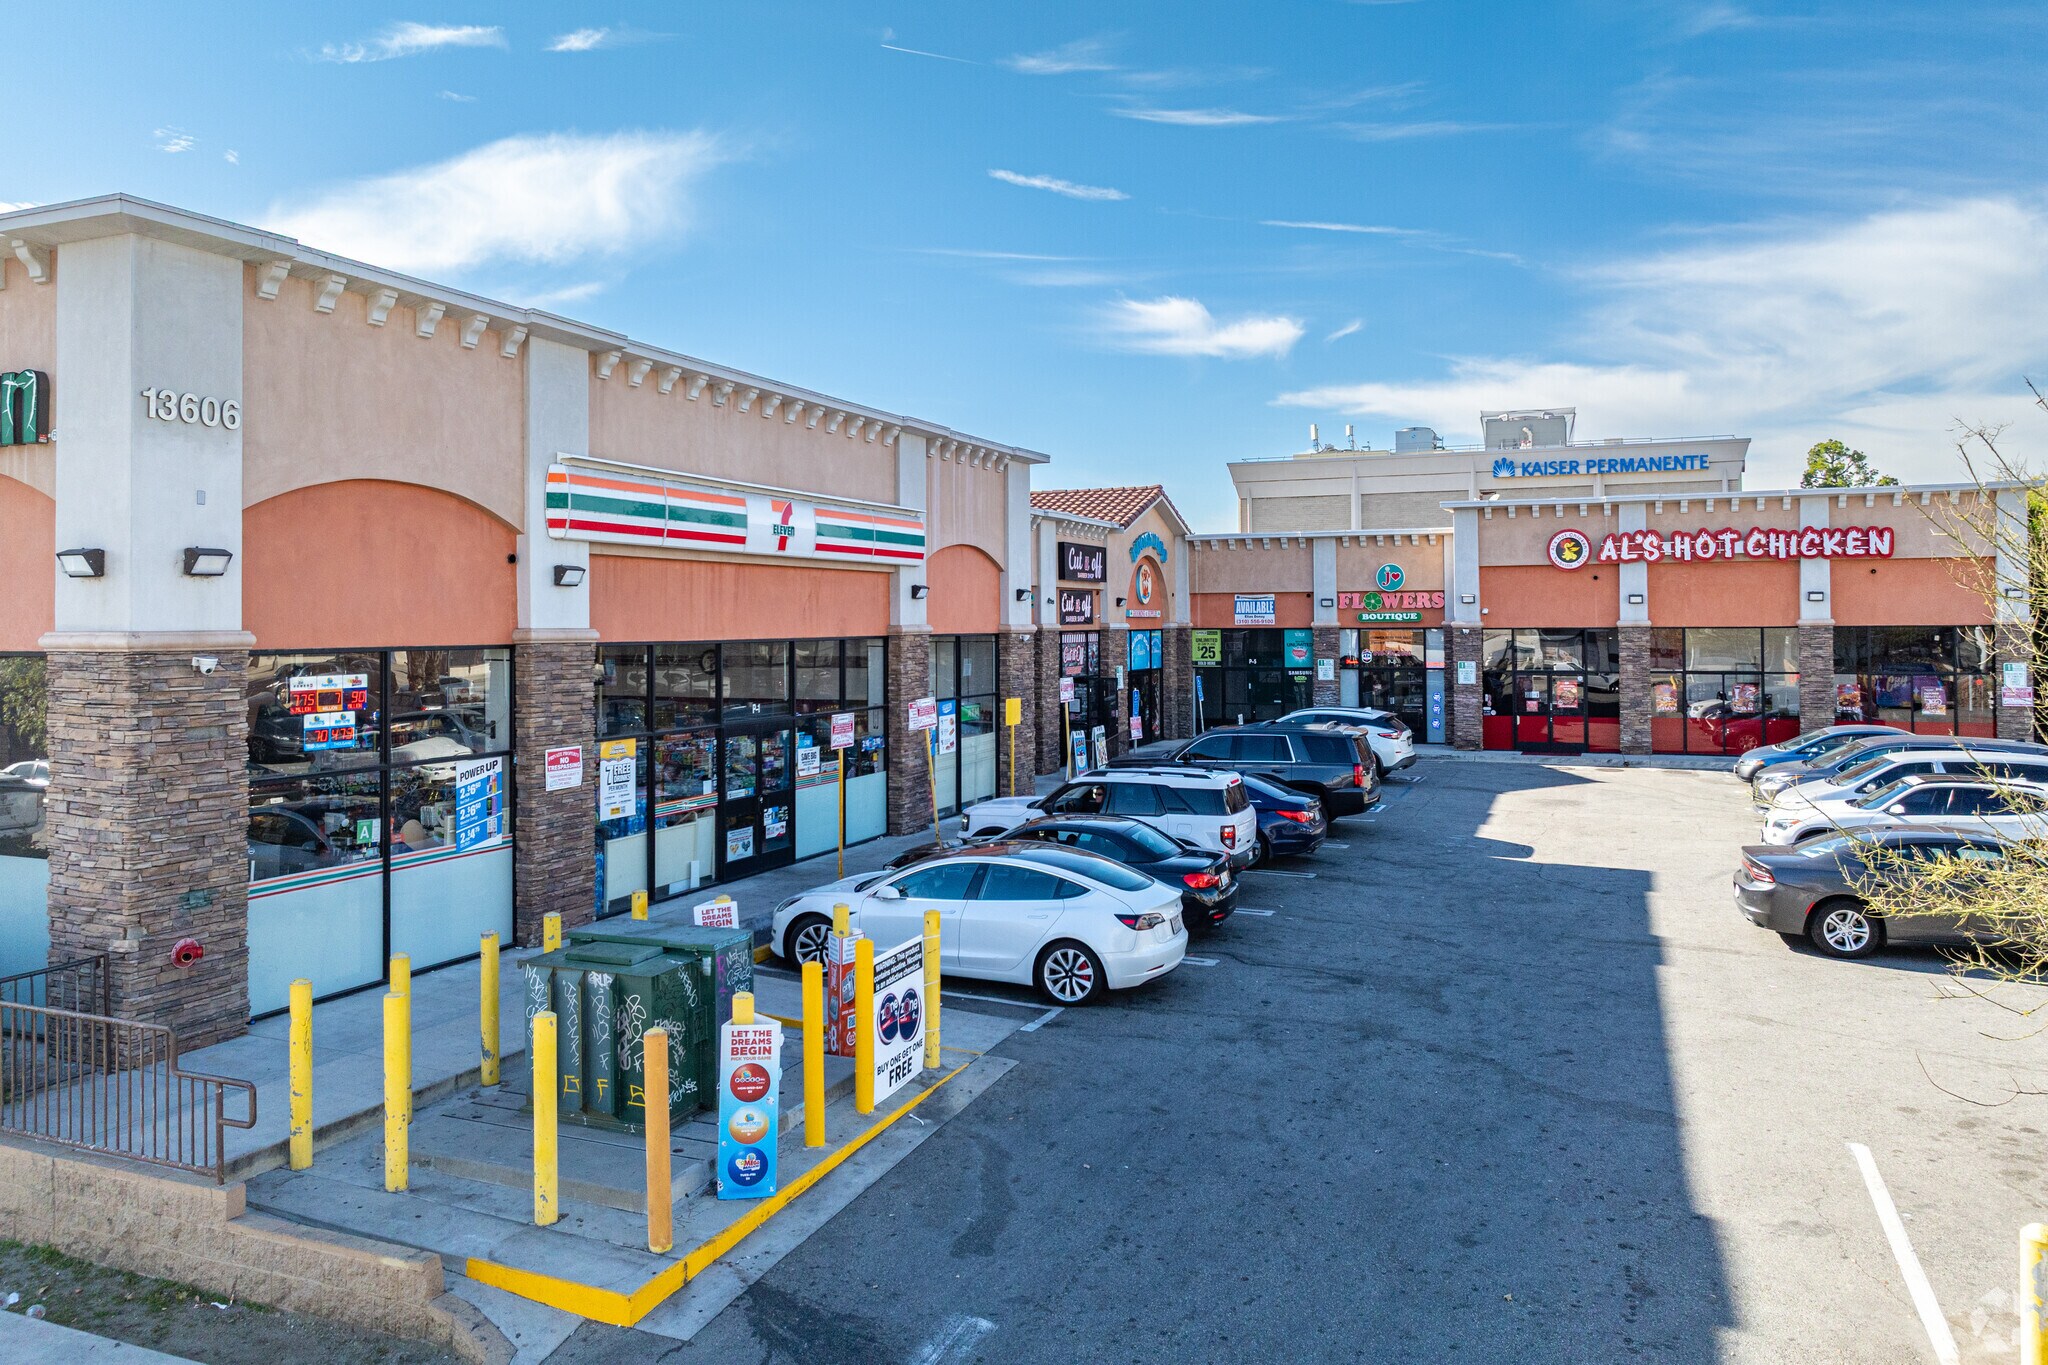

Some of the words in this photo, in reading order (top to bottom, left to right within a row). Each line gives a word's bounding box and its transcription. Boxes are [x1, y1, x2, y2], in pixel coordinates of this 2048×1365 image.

[142, 387, 241, 430] 13606
[1521, 460, 1580, 477] KAISER
[1586, 454, 1710, 474] PERMANENTE
[771, 500, 793, 551] 7
[1600, 531, 1661, 561] AL'S
[1674, 530, 1739, 563] HOT
[1747, 526, 1891, 559] CHICKEN
[1068, 547, 1083, 570] Cut
[1091, 552, 1102, 579] off
[1061, 593, 1074, 612] Cut
[1081, 595, 1092, 617] off
[1235, 601, 1274, 614] AVAILABLE
[1361, 612, 1418, 620] BOUTIQUE
[548, 761, 581, 771] TRESPASSING
[560, 756, 570, 764] NO
[460, 764, 485, 782] POWER
[486, 760, 499, 772] UP
[613, 763, 631, 775] FREE
[359, 825, 370, 839] A
[702, 912, 732, 921] DREAMS
[702, 918, 732, 927] BEGIN
[875, 955, 897, 973] WARNING:
[897, 951, 905, 961] This
[905, 943, 920, 960] product
[874, 969, 891, 983] contains
[906, 952, 922, 965] Nicotine
[885, 972, 903, 986] addictive
[880, 999, 899, 1021] zone
[900, 998, 918, 1014] zone
[731, 1030, 749, 1038] LET
[731, 1038, 772, 1046] DREAMS
[730, 1046, 772, 1056] BEGIN
[877, 1060, 889, 1076] BUY
[890, 1052, 902, 1067] ONE
[902, 1045, 912, 1059] GET
[912, 1038, 924, 1052] ONE
[889, 1056, 913, 1088] FREE
